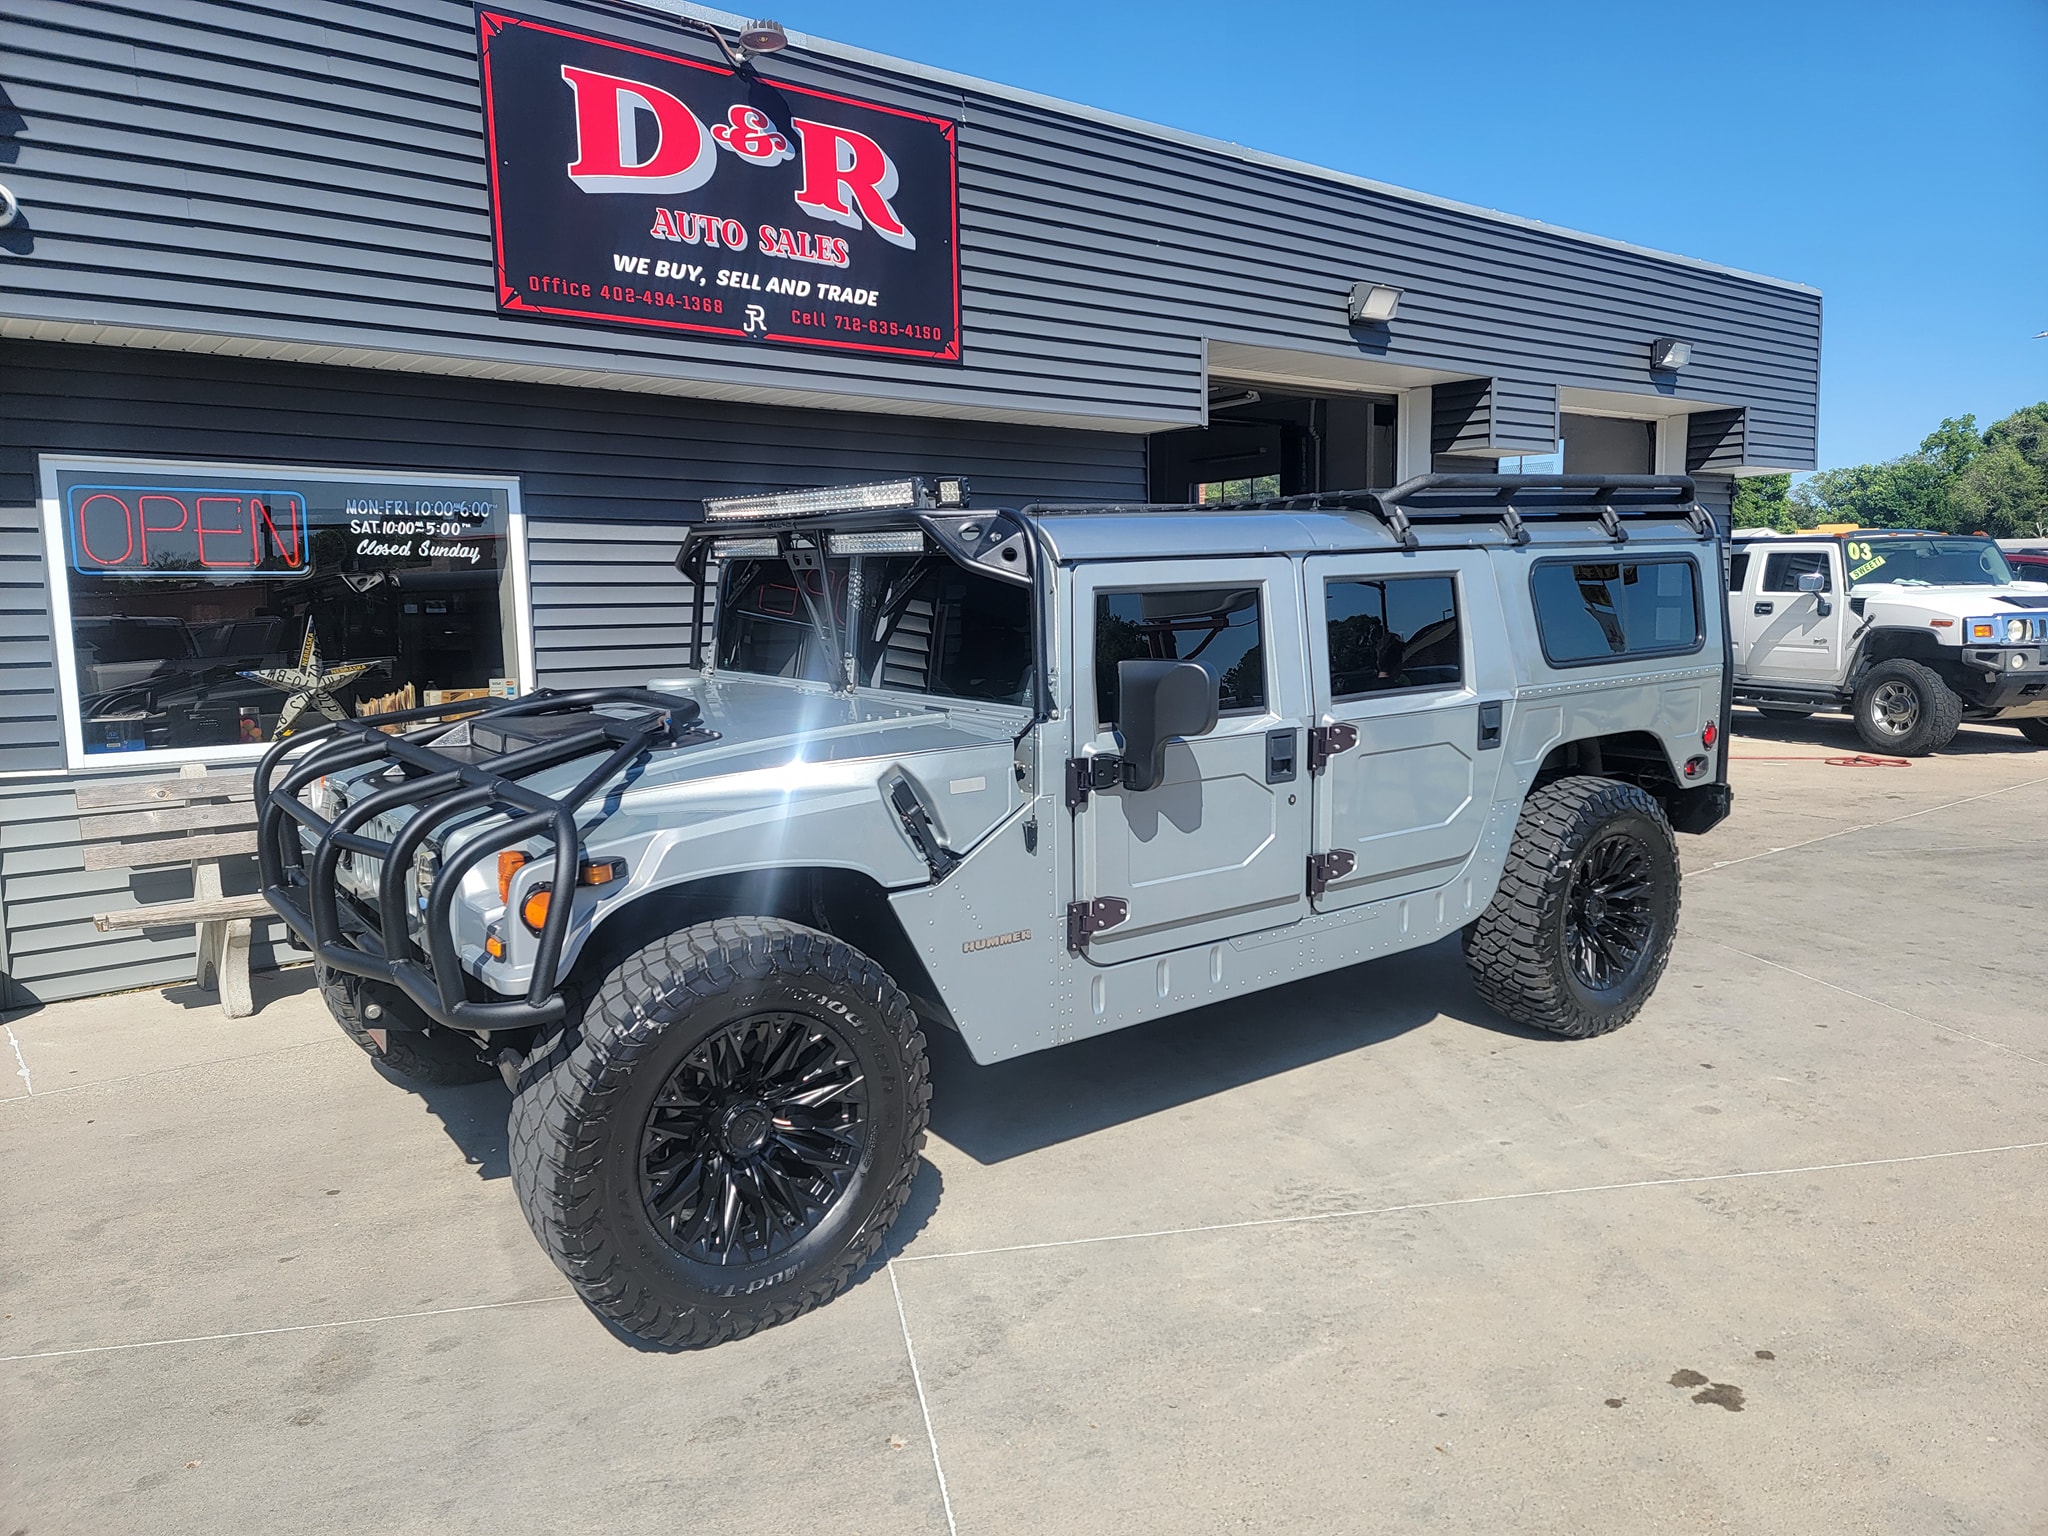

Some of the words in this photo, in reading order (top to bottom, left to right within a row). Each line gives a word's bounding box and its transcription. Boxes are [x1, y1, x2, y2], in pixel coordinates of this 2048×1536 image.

[650, 207, 749, 252] AUTO
[758, 224, 851, 269] SALES
[528, 275, 591, 298] Office
[600, 285, 723, 314] 402-494-1368
[613, 254, 650, 275] WE
[654, 260, 707, 287] BUY,
[716, 269, 761, 291] SELL
[765, 276, 811, 297] AND
[817, 283, 879, 307] TRADE
[791, 309, 826, 328] Cell
[834, 314, 941, 341] 712-635-4150
[80, 493, 301, 568] OPEN
[350, 519, 381, 534] SAT.
[356, 538, 413, 557] Closed
[418, 540, 481, 564] Sunday
[1847, 541, 1873, 561] 03
[1852, 557, 1883, 578] SWEET!
[962, 929, 1031, 954] HUMMER
